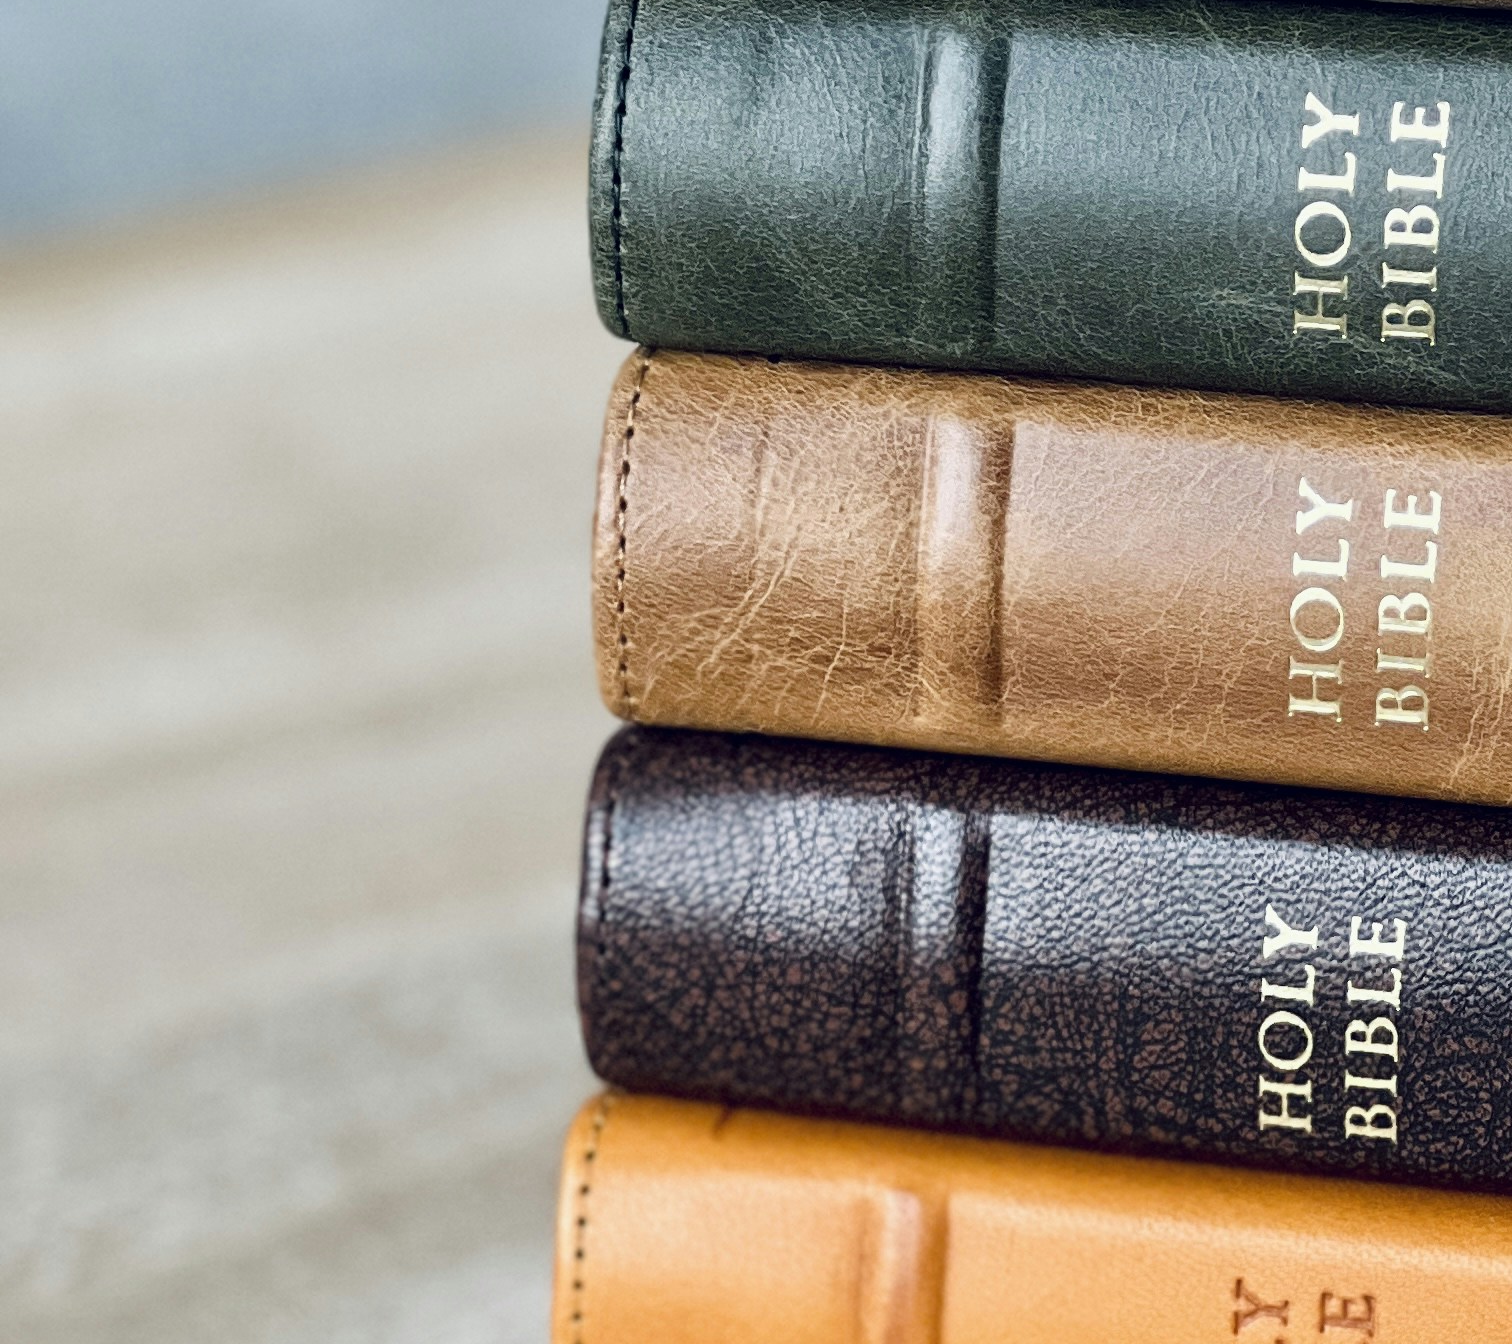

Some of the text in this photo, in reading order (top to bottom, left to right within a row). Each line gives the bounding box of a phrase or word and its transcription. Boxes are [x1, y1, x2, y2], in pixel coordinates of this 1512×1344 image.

[1293, 91, 1359, 339] HOLY
[1381, 101, 1450, 346] BIBLE
[1288, 476, 1352, 722] HOLY
[1374, 488, 1442, 731] BIBLE
[1258, 903, 1318, 1133] HOLY
[1344, 915, 1407, 1144] BIBLE
